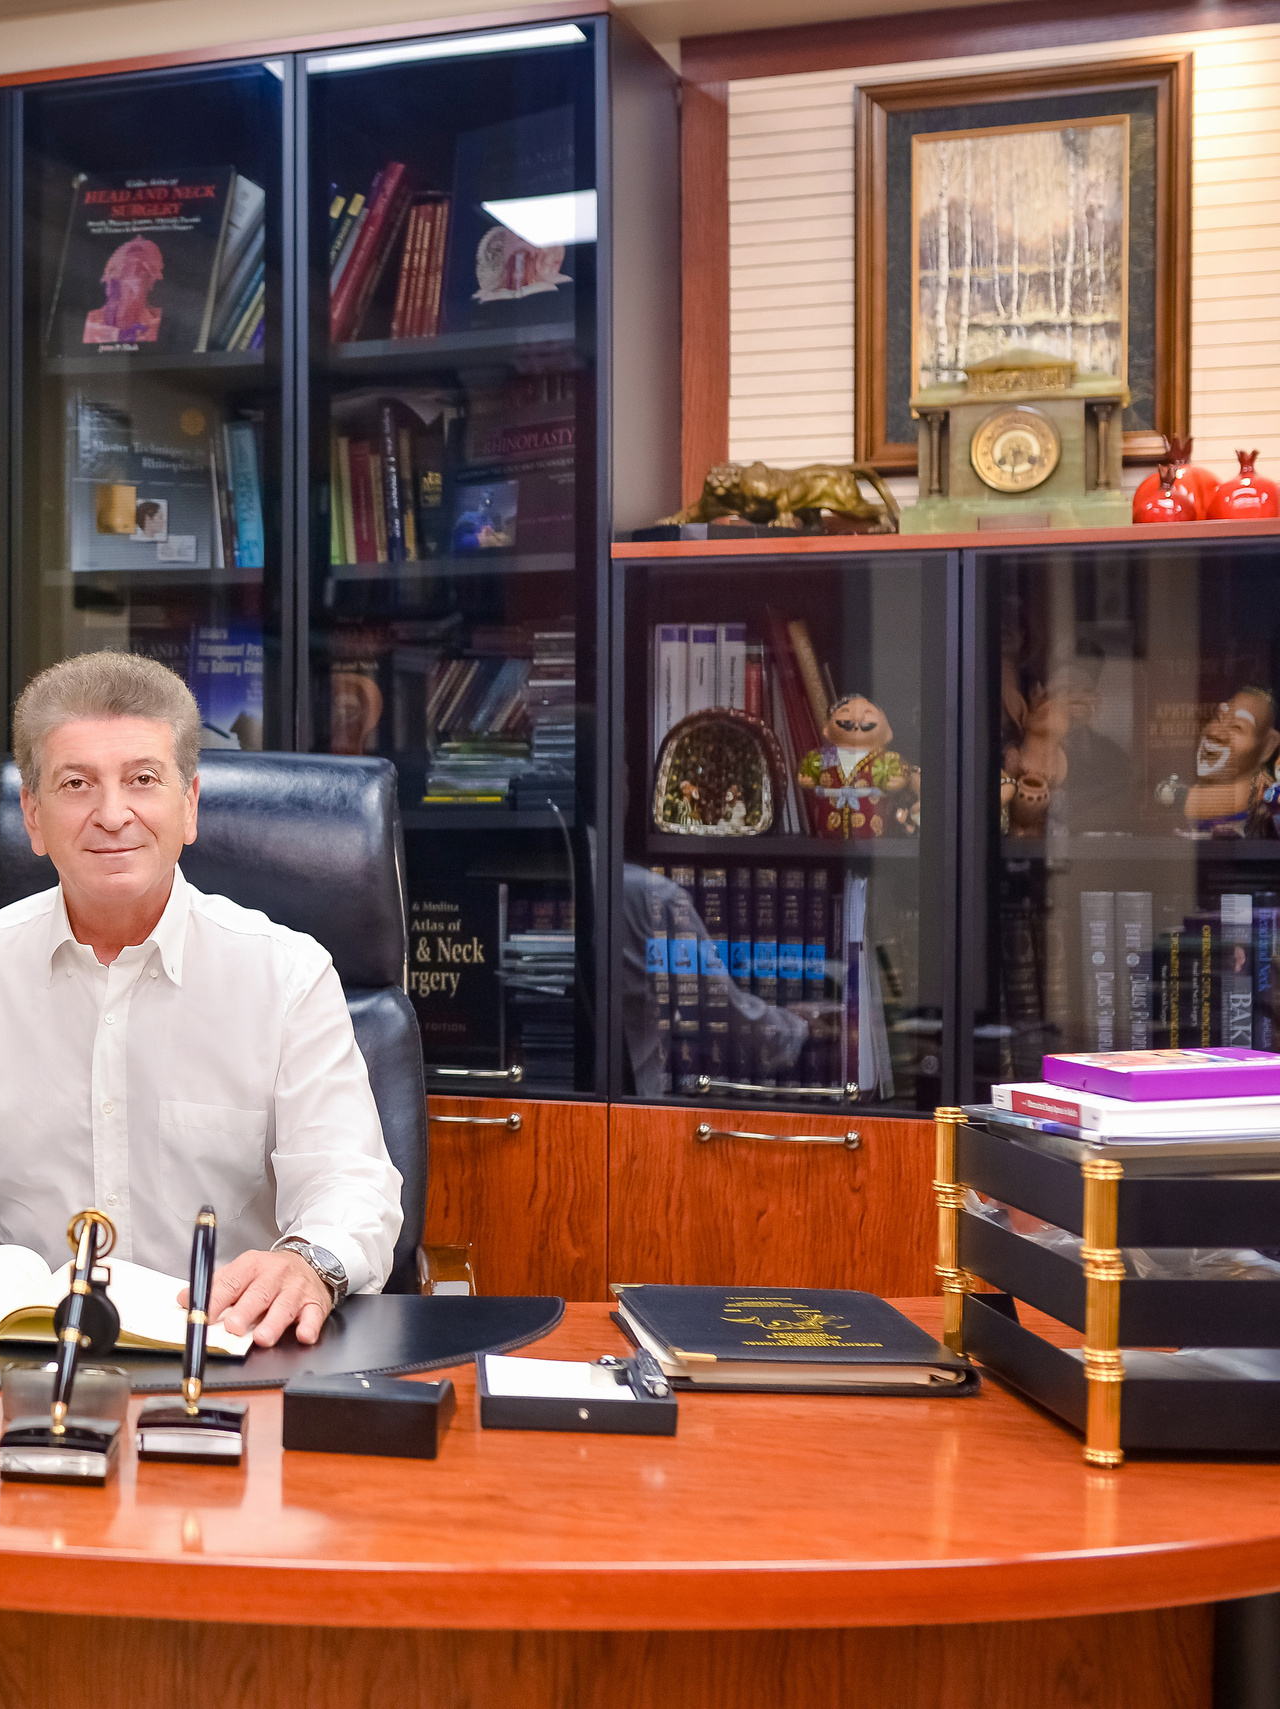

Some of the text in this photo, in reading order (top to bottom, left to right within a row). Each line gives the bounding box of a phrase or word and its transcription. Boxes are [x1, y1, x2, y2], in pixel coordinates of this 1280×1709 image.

[84, 185, 216, 204] HEAD AND NECK
[111, 202, 183, 219] SURGERY
[482, 427, 575, 454] RHINOPLASTY
[412, 901, 460, 912] & Medina
[411, 918, 462, 932] Atlas of
[1259, 908, 1273, 938] Head
[416, 936, 486, 964] & Neck
[1202, 925, 1211, 975] OPERATIVE
[410, 970, 461, 998] rgery
[1259, 963, 1273, 992] Neck
[425, 1022, 467, 1032] EDITION
[1229, 992, 1252, 1049] BAK
